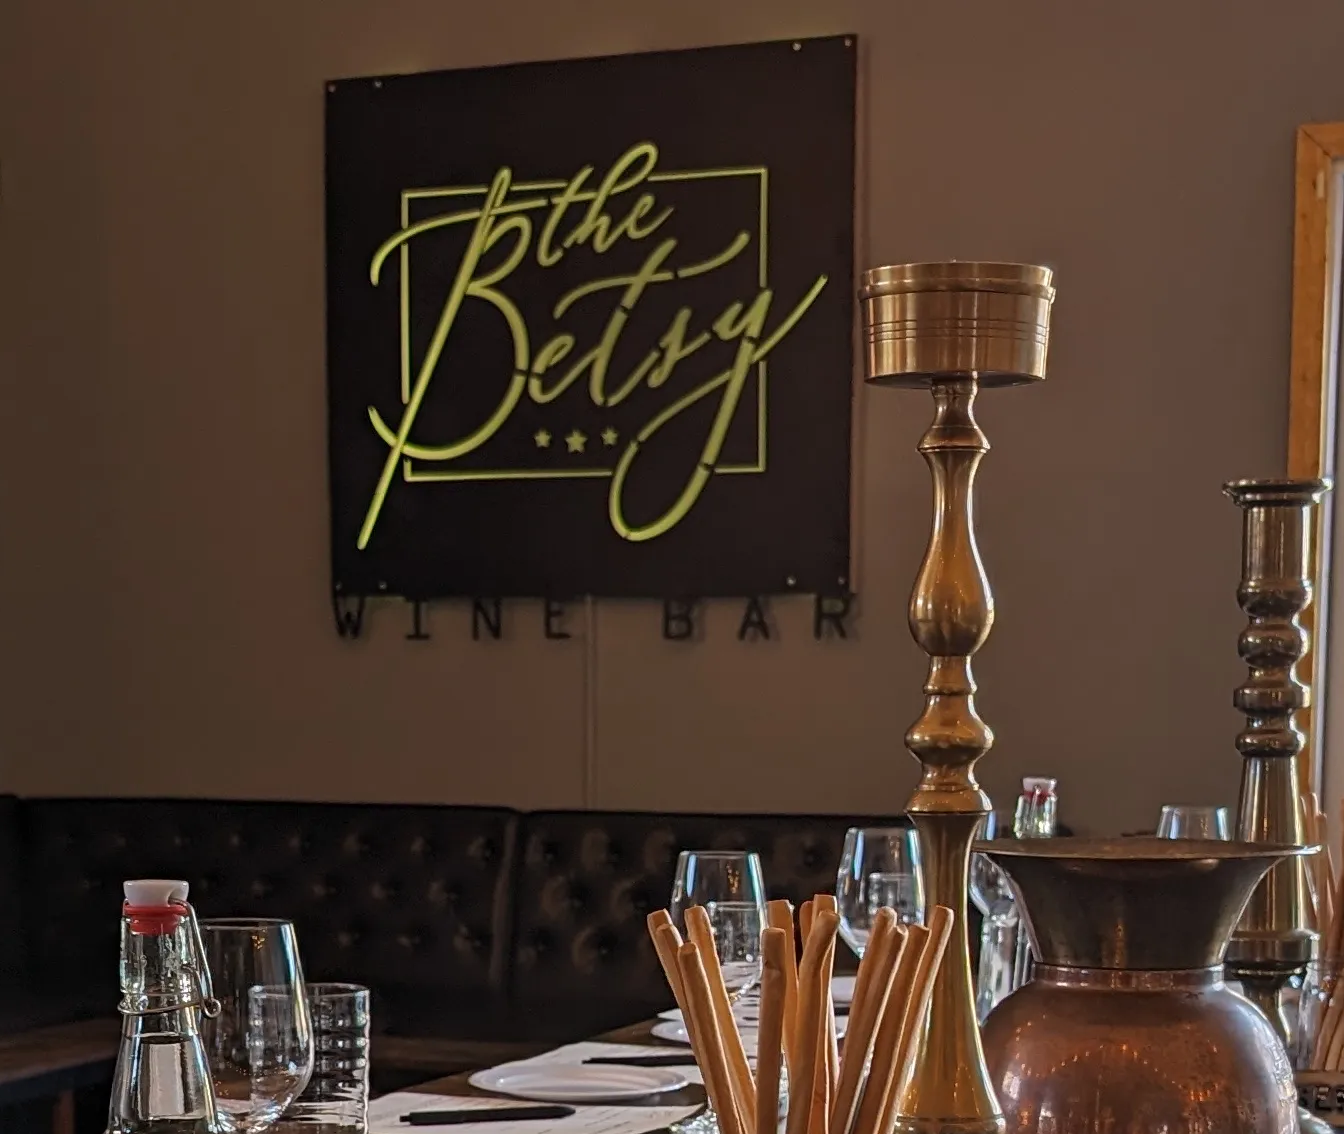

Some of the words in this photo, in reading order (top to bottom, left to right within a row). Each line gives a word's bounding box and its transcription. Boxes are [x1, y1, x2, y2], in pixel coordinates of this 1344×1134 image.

[537, 141, 674, 268] the
[357, 167, 828, 549] Betsy
[332, 594, 572, 641] WINE
[661, 594, 852, 641] BAR
